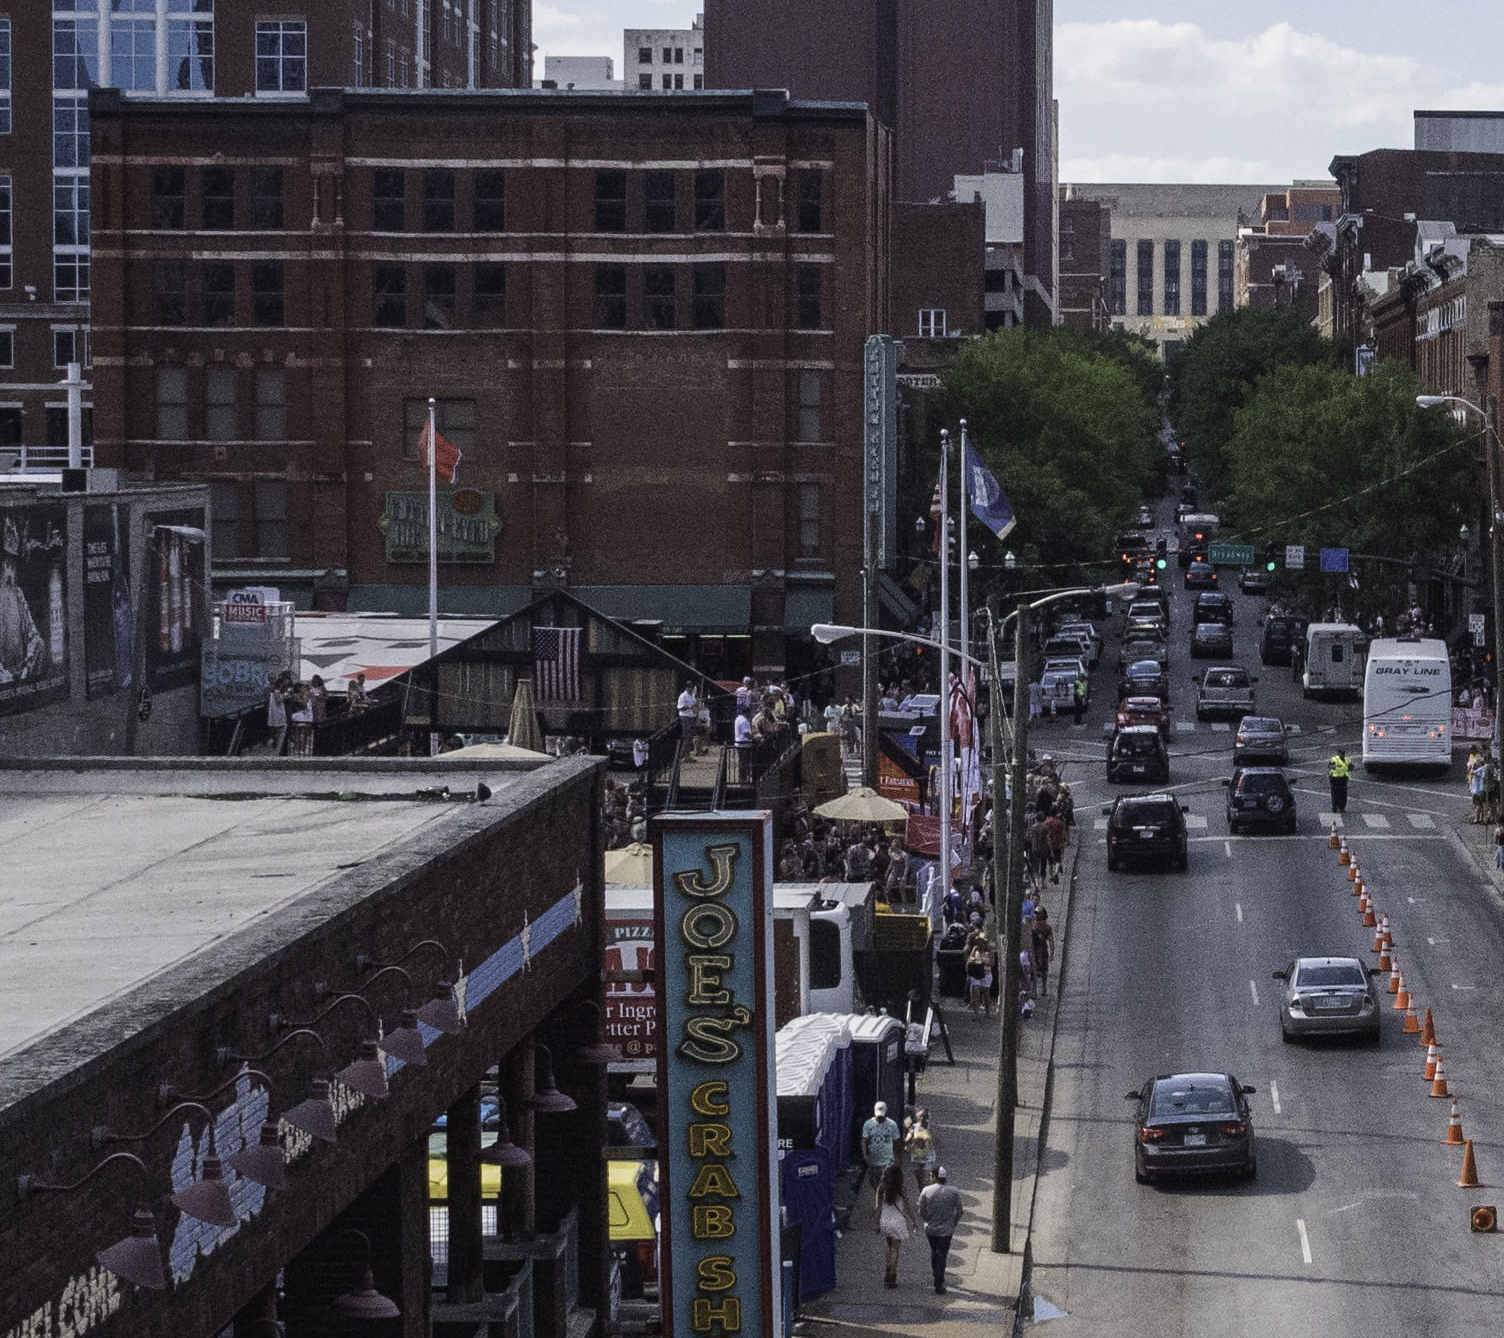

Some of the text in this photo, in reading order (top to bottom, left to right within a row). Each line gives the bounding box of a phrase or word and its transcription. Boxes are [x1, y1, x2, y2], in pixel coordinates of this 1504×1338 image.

[232, 593, 259, 604] CMA
[229, 606, 263, 617] MUSIC
[203, 660, 270, 689] SOBR
[1376, 667, 1410, 675] GRAY
[614, 925, 655, 939] PIZZ
[676, 843, 753, 1065] JOE'S
[777, 1138, 793, 1149] RE
[689, 1080, 739, 1240] CRAB
